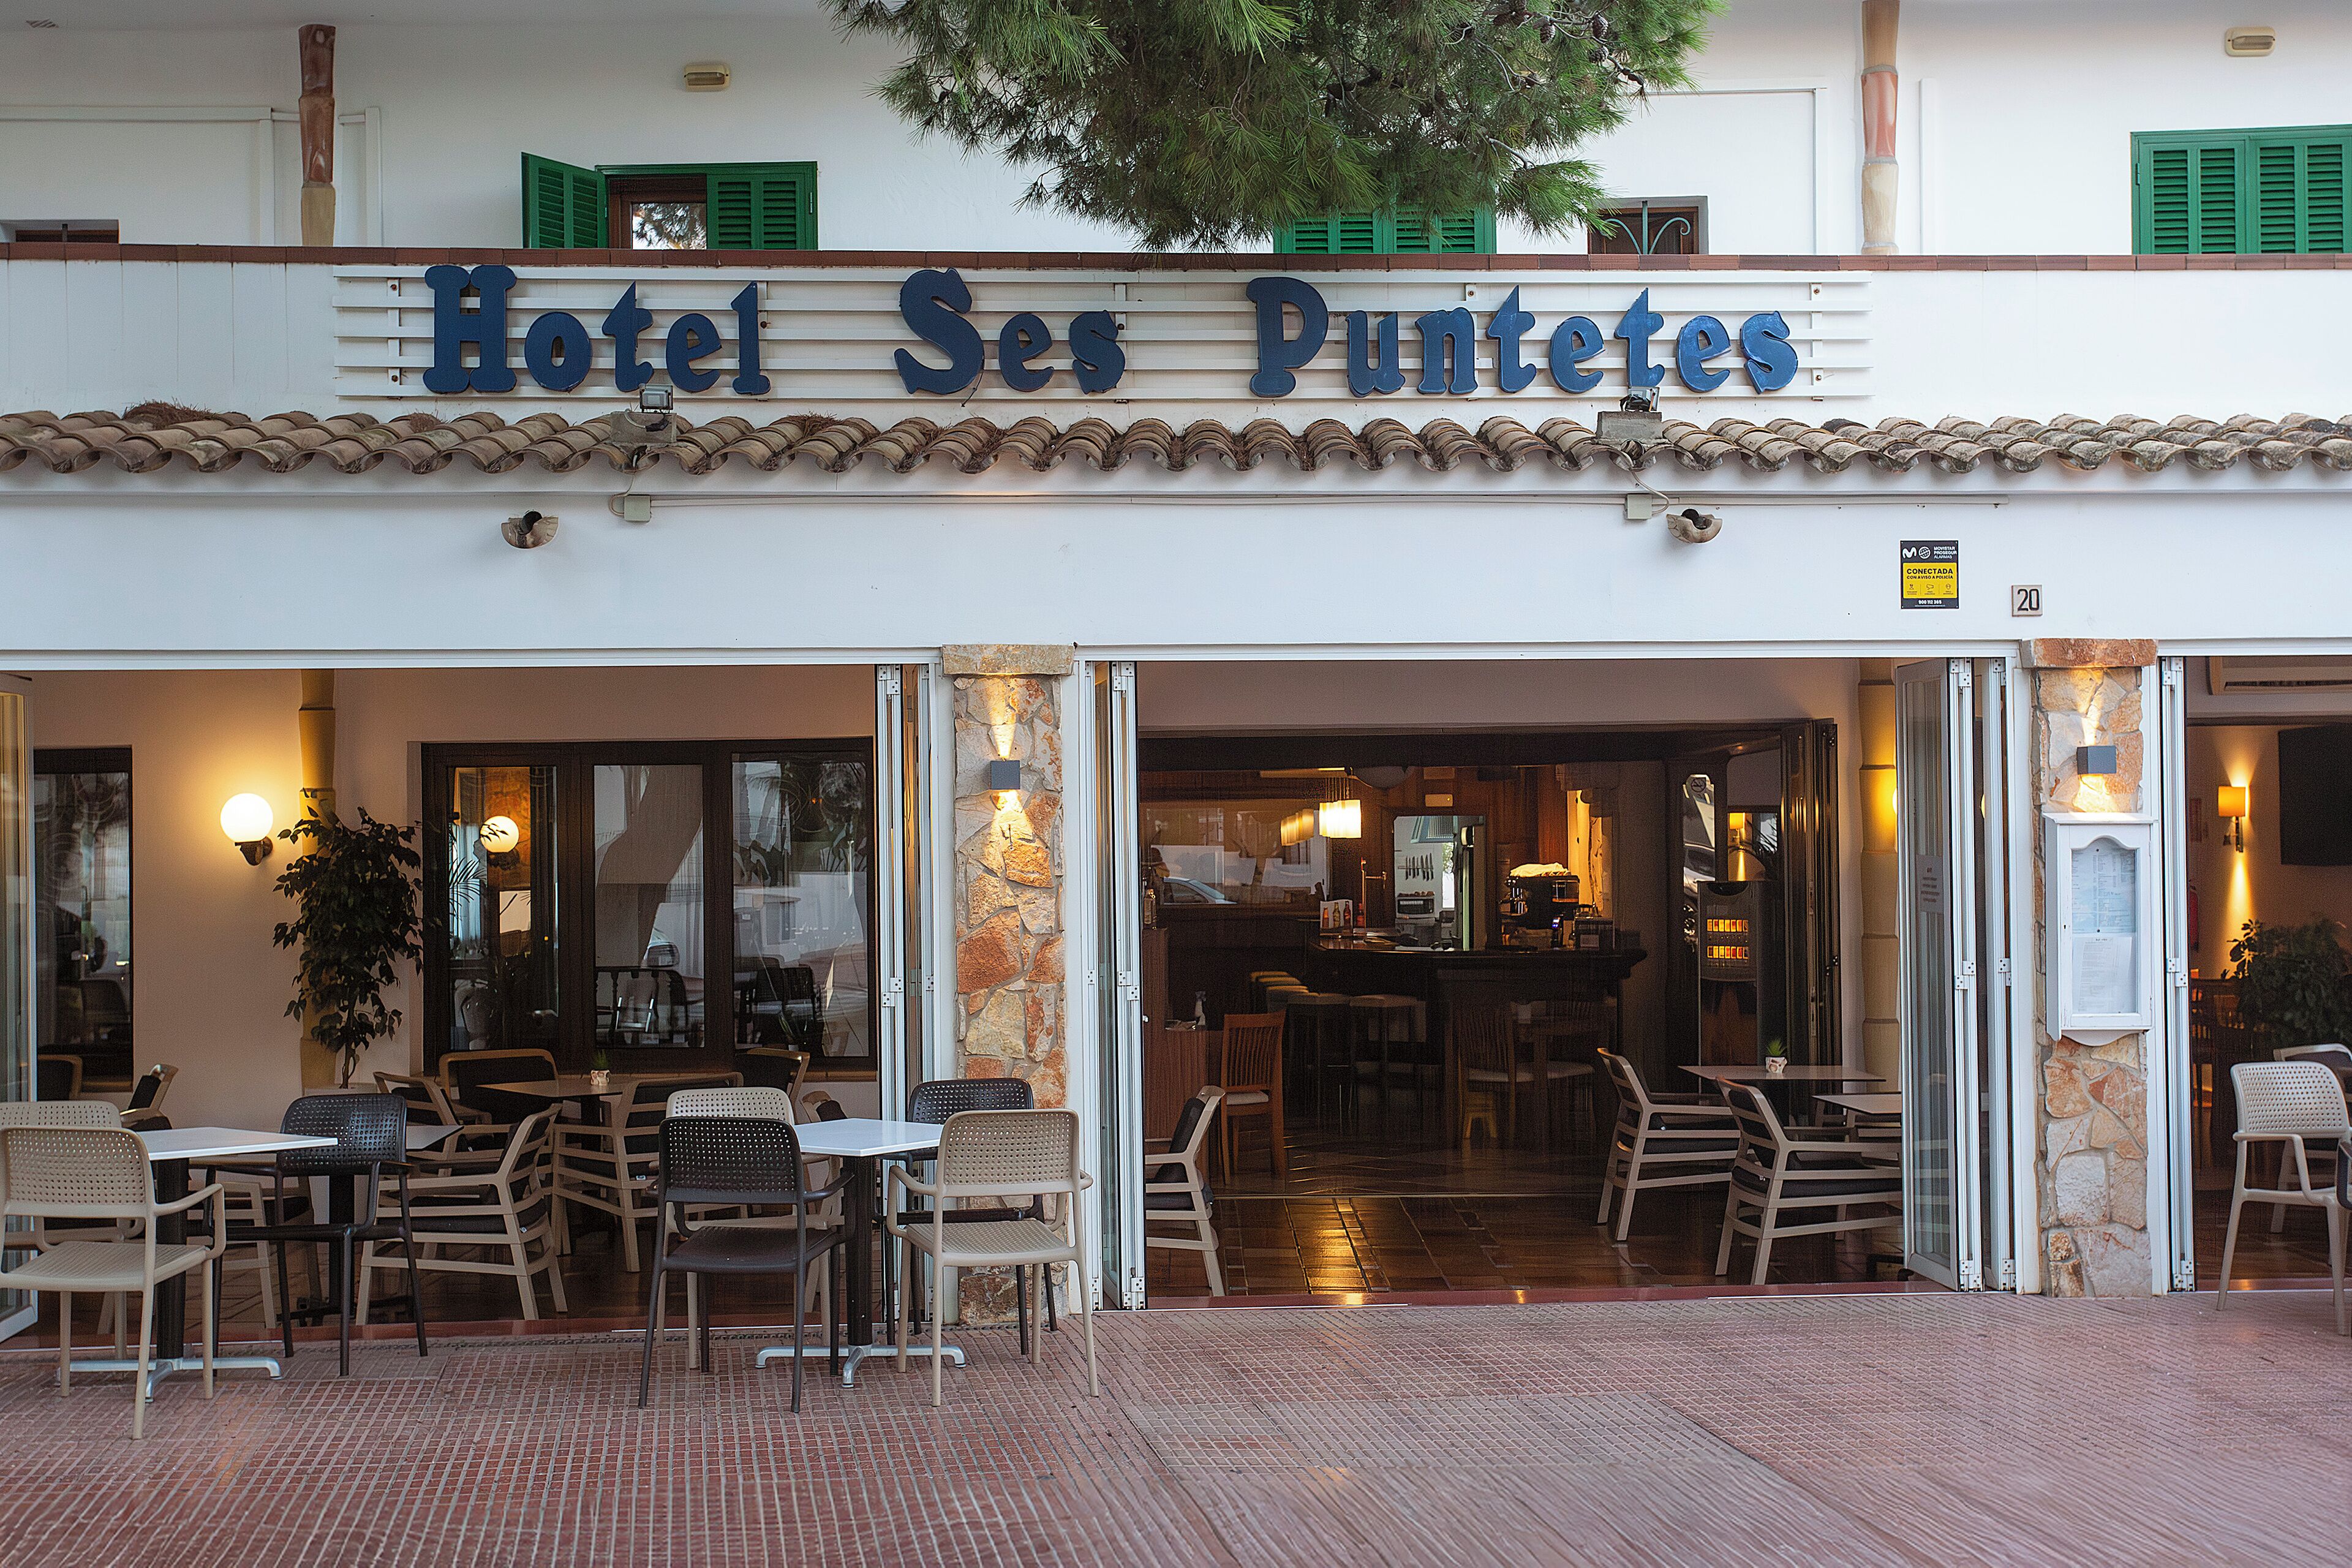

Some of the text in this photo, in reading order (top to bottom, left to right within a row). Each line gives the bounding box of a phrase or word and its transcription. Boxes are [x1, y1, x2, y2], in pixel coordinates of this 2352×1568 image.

[423, 265, 1798, 396] Hotel Ses Puntetes
[2018, 589, 2040, 611] 20
